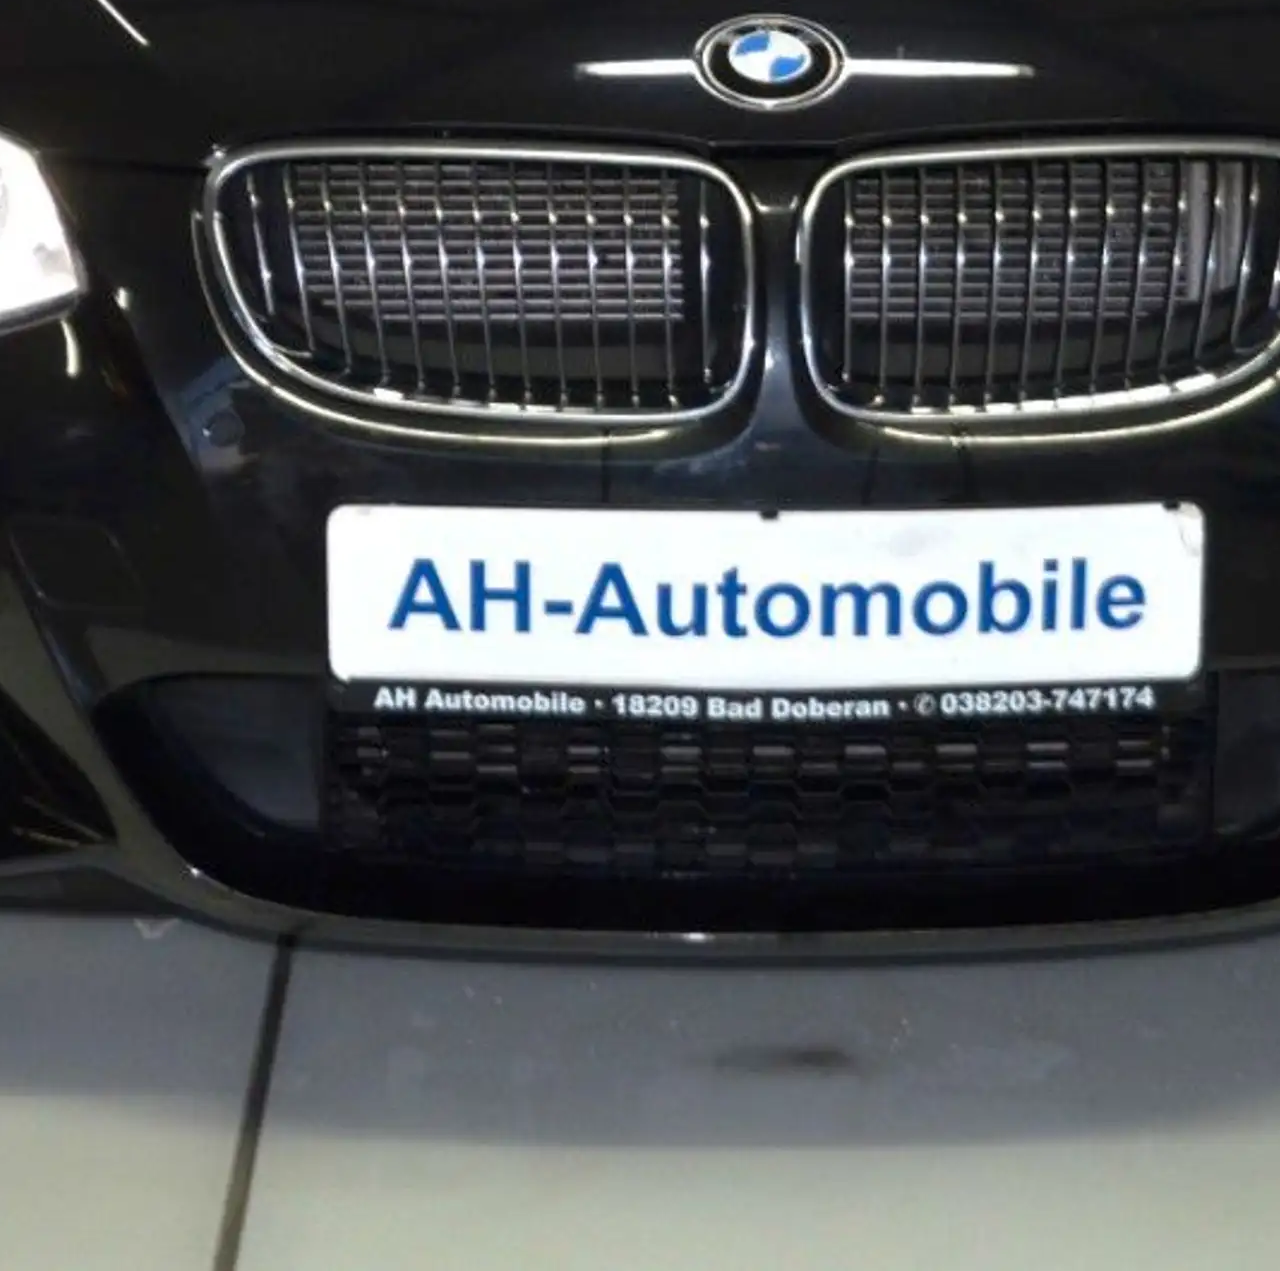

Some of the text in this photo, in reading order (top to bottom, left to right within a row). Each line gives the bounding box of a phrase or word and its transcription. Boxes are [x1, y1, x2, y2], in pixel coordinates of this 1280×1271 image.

[388, 558, 1148, 638] AH-Automobile
[374, 684, 1155, 721] AH Automobile 18209 Bad Doberan 038203-747174
